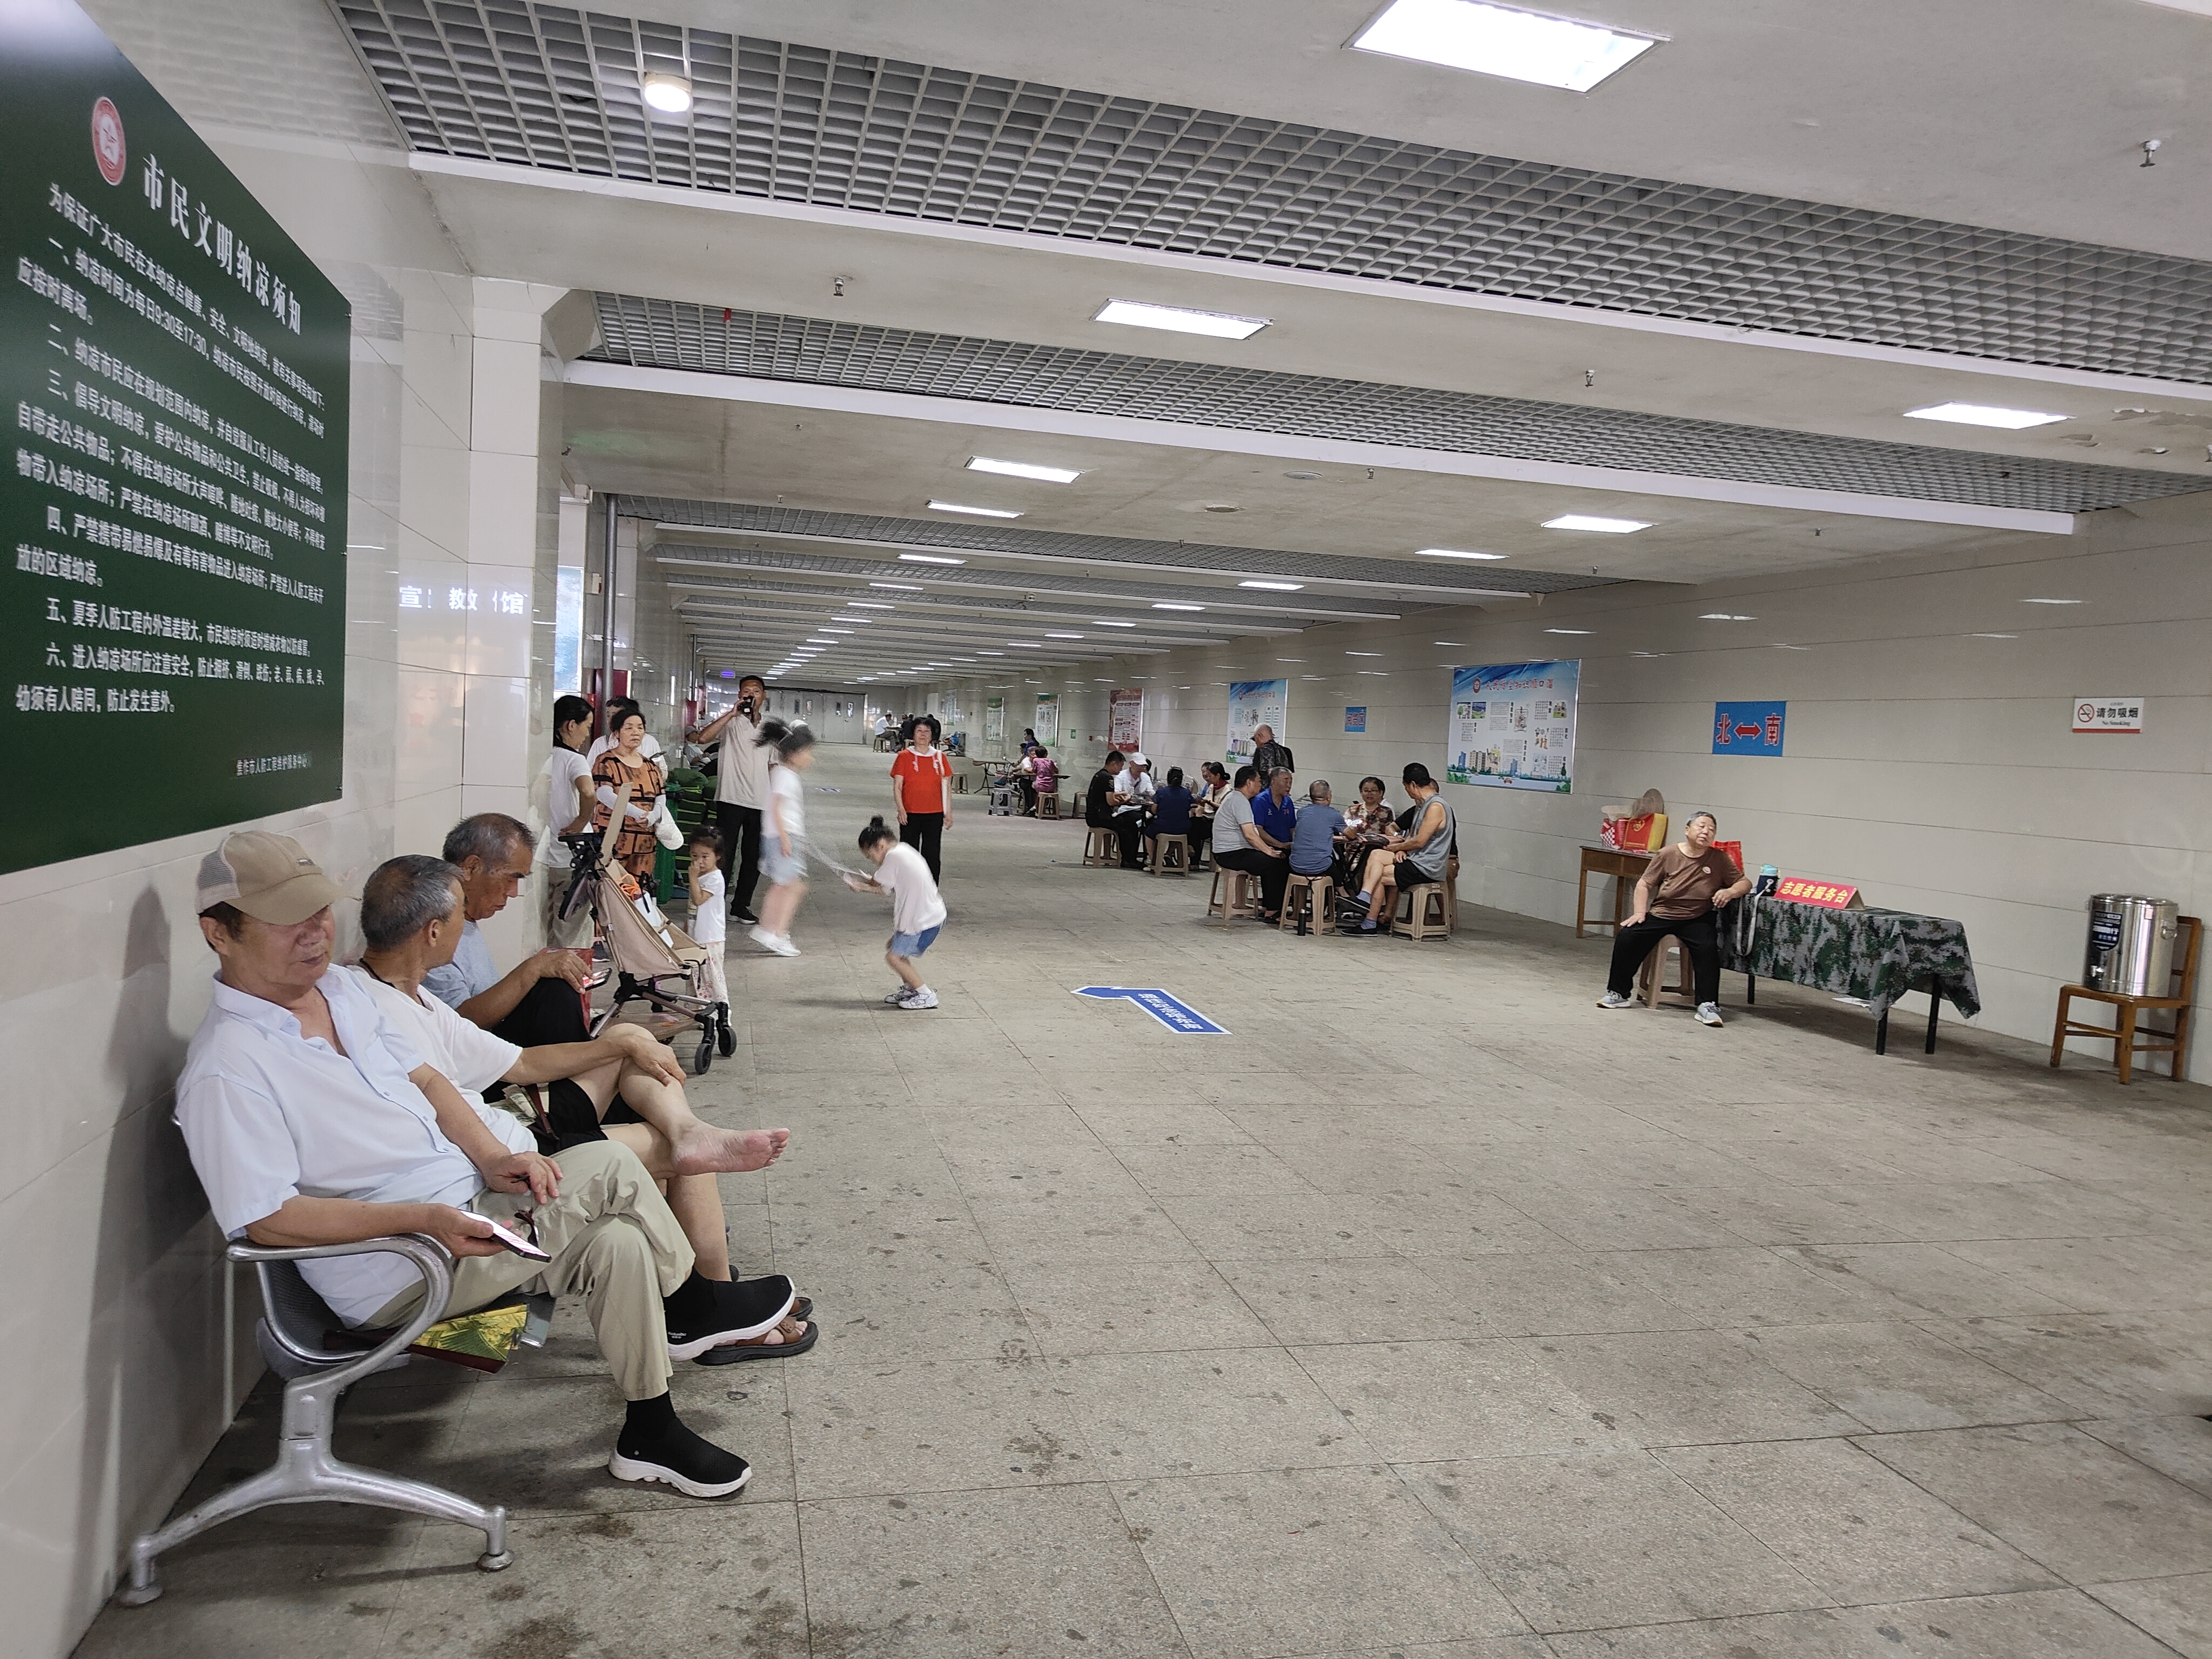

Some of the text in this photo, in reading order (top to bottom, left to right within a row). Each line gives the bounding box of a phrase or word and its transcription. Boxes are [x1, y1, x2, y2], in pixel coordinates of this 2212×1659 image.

[143, 154, 300, 335] 市民文明纳凉须知
[17, 257, 92, 325] 应按时离场。
[16, 544, 103, 587] 放的区域纳凉。
[15, 685, 174, 712] 幼须有人陪同，防止发生意外。
[2096, 707, 2139, 718] 请勿吸烟
[1716, 713, 1782, 746] 北 南
[1780, 881, 1849, 903] 志愿者服务台
